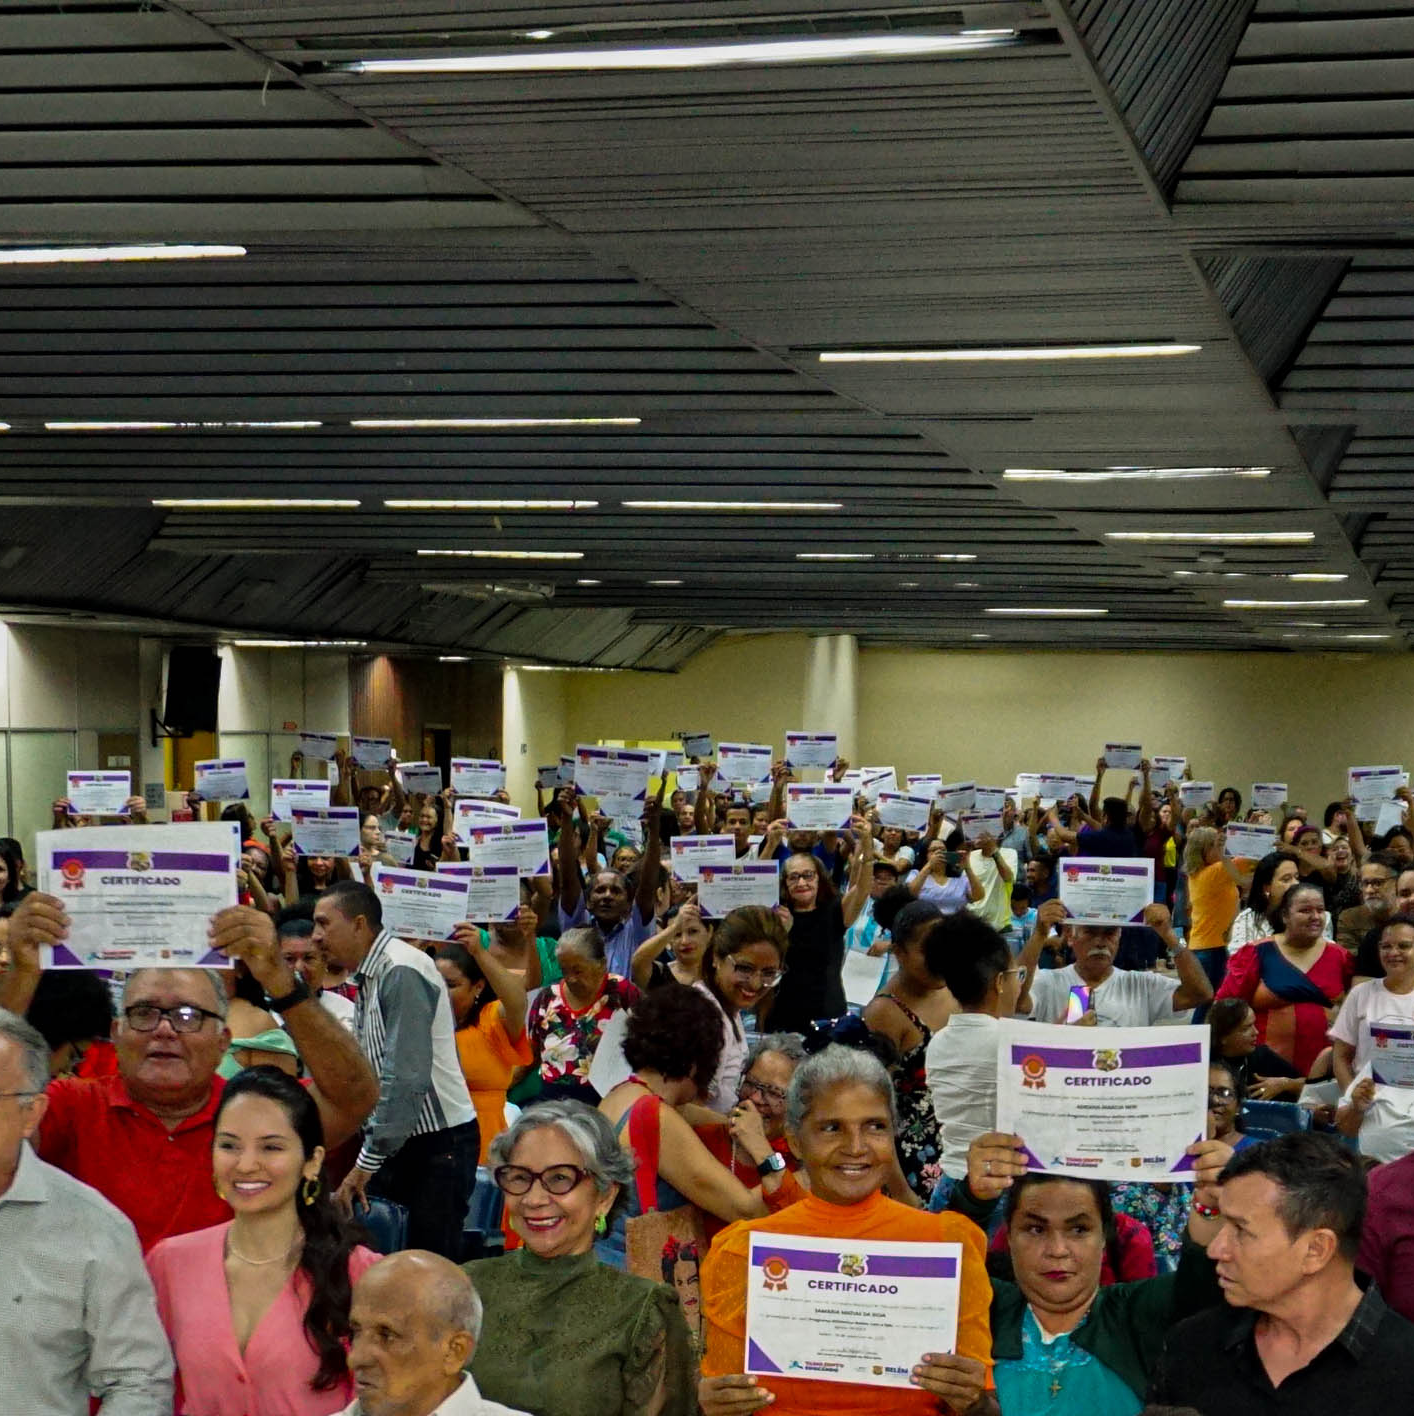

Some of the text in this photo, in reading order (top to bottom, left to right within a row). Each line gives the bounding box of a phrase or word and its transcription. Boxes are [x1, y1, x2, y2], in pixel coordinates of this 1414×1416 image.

[101, 876, 181, 885] CERTIFICADO
[1064, 1076, 1152, 1086] CERTIFICADO
[807, 1280, 898, 1294] CERTIFICADO
